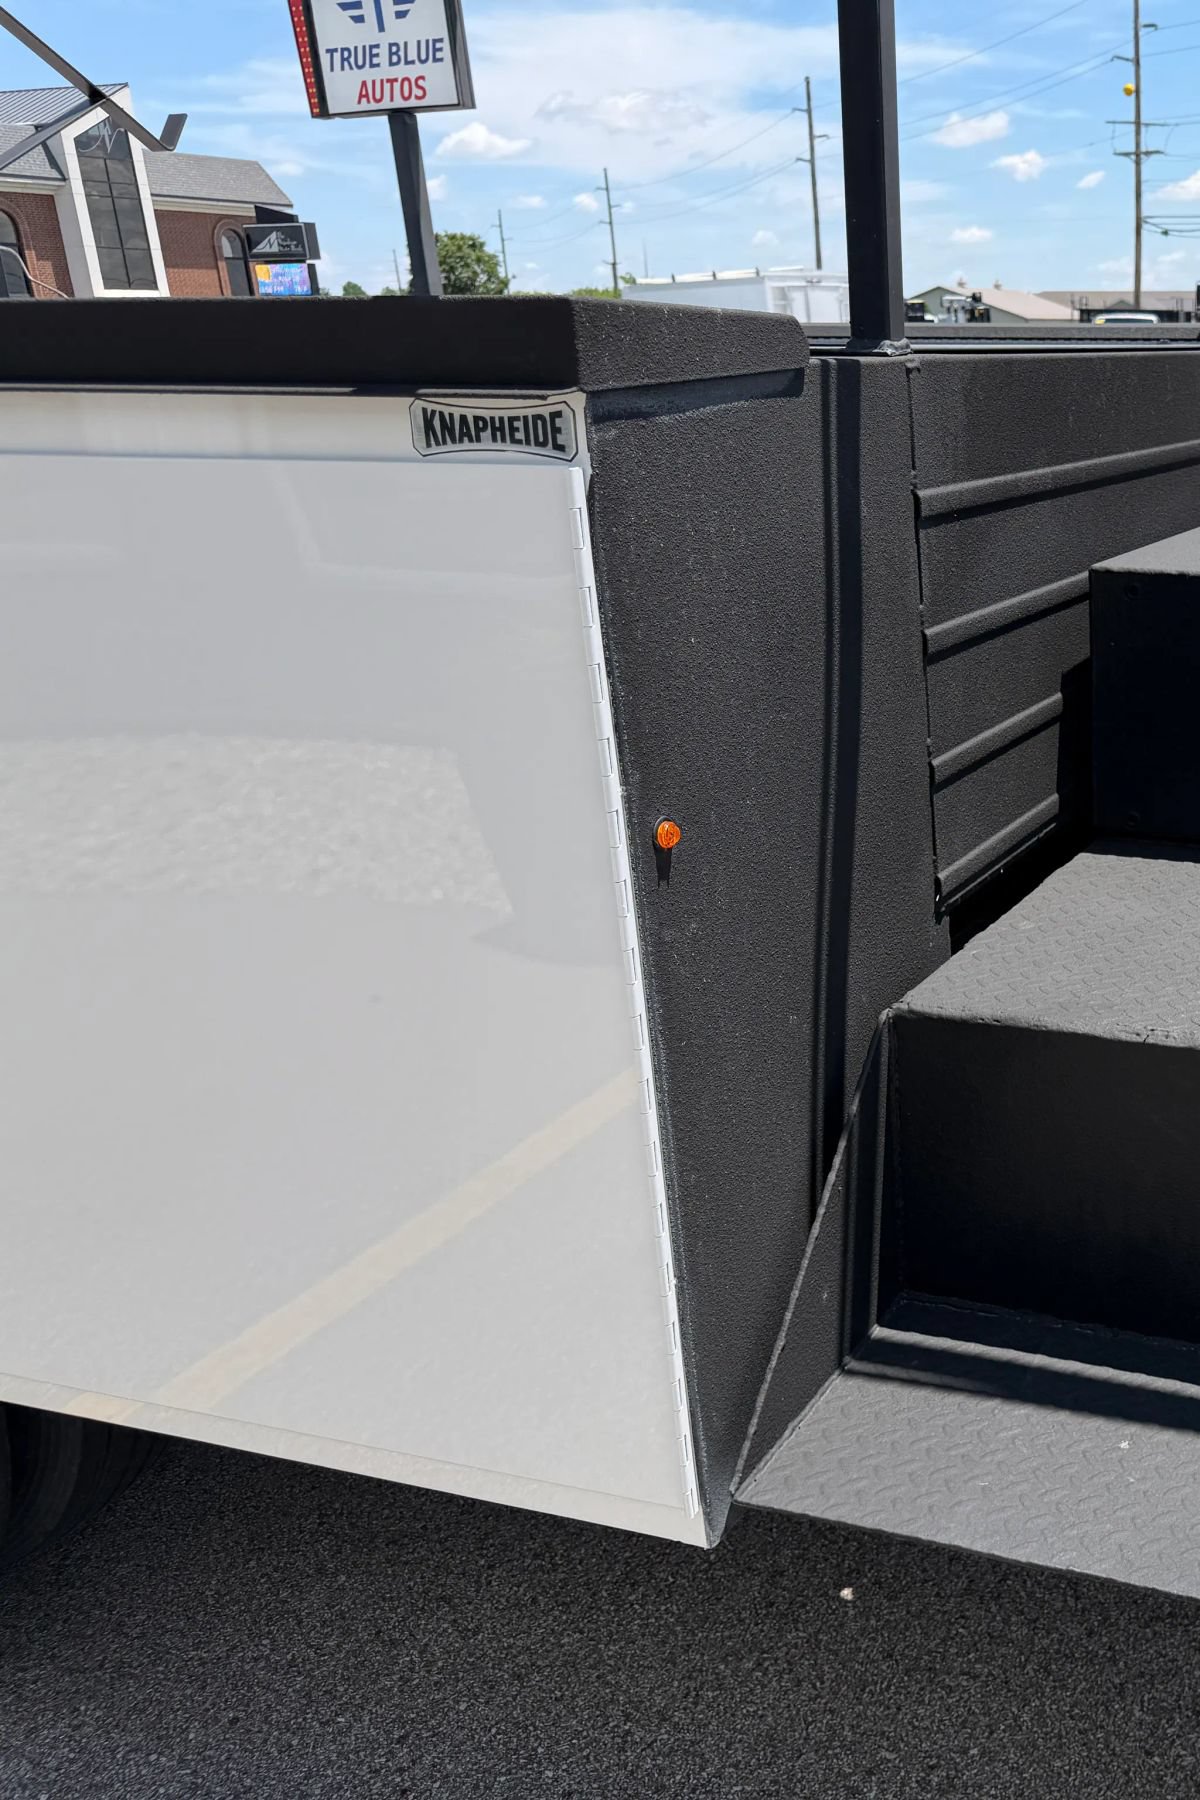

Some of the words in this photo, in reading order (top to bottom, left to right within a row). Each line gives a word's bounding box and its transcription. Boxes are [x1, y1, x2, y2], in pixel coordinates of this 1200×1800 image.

[325, 43, 381, 73] TRUE
[388, 37, 445, 67] BLUE
[357, 75, 428, 105] AUTOS
[421, 406, 567, 453] KNAPHEIDE
